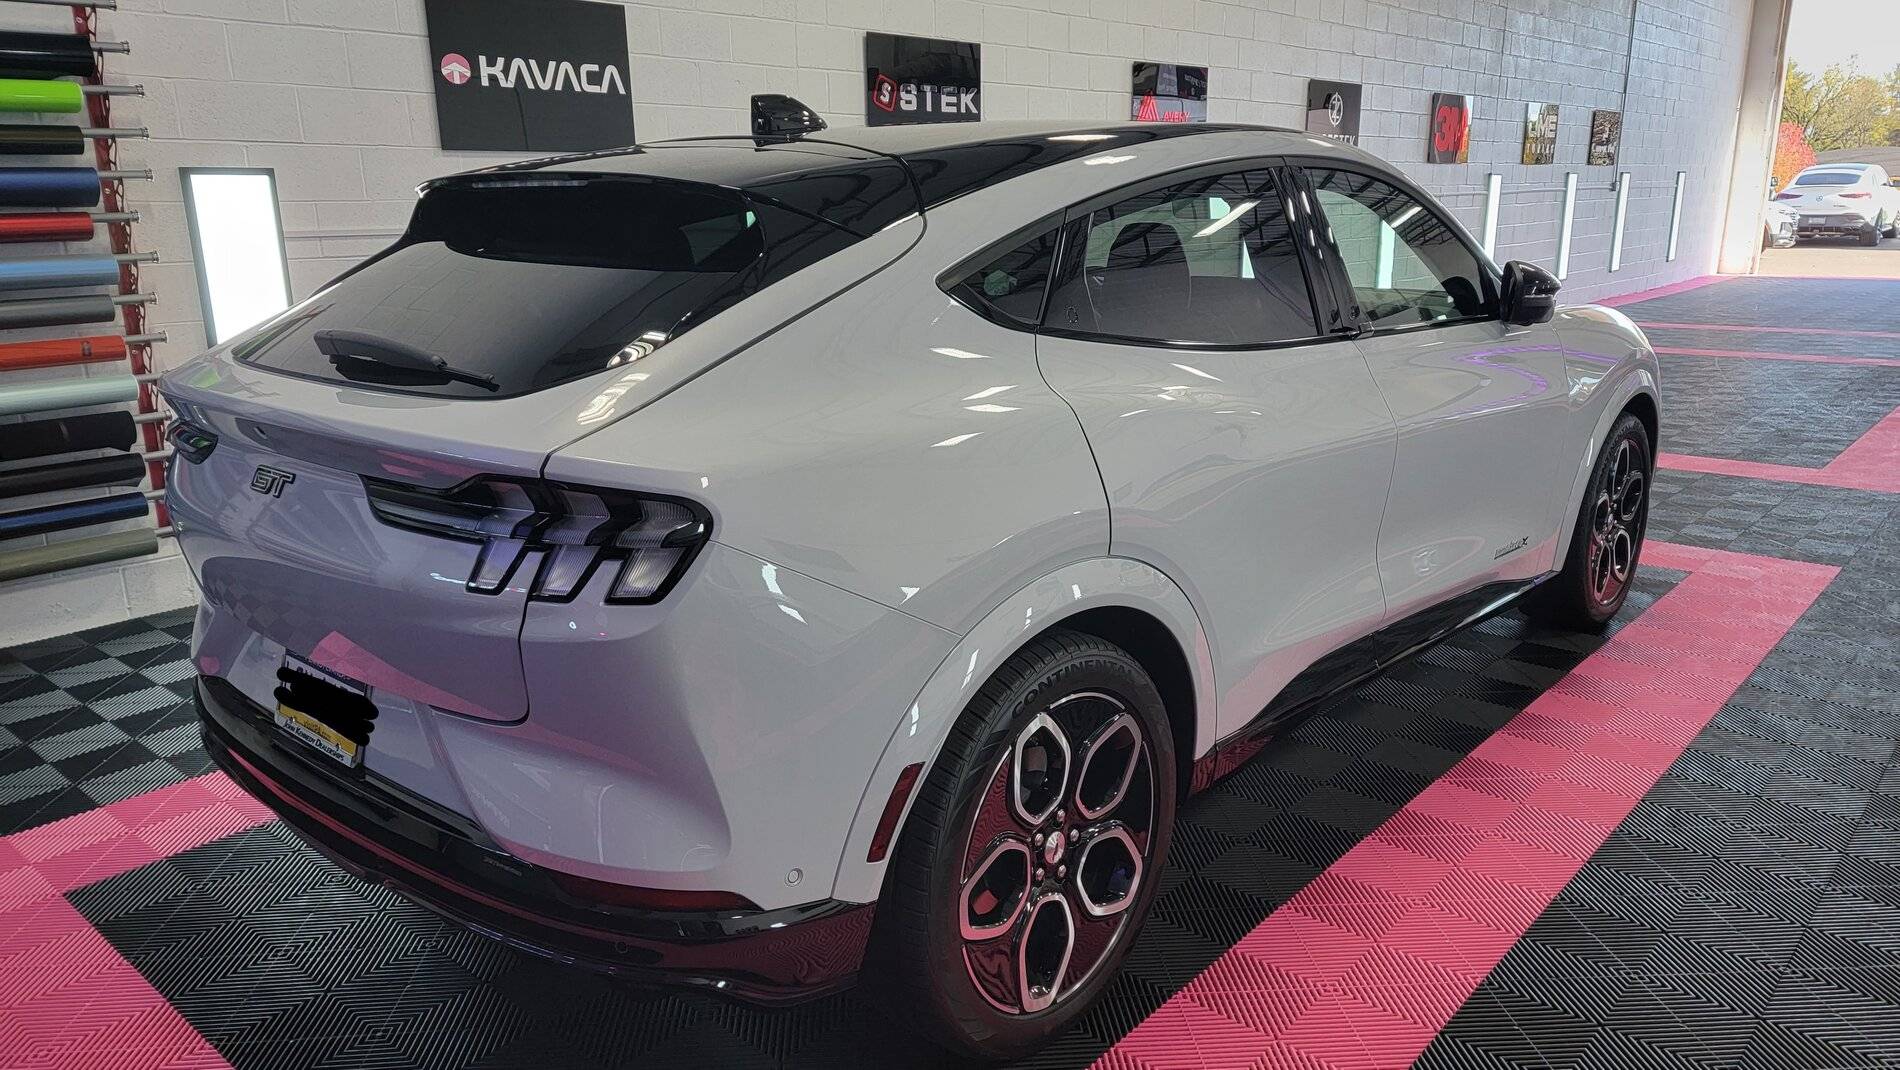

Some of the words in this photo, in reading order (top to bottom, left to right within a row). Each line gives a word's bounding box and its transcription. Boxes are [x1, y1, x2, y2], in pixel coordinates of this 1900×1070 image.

[478, 54, 626, 95] KAVACA
[899, 83, 978, 114] STEK
[1435, 105, 1469, 152] 3M
[250, 464, 297, 499] GT
[1011, 659, 1132, 719] CONTINENTAL
